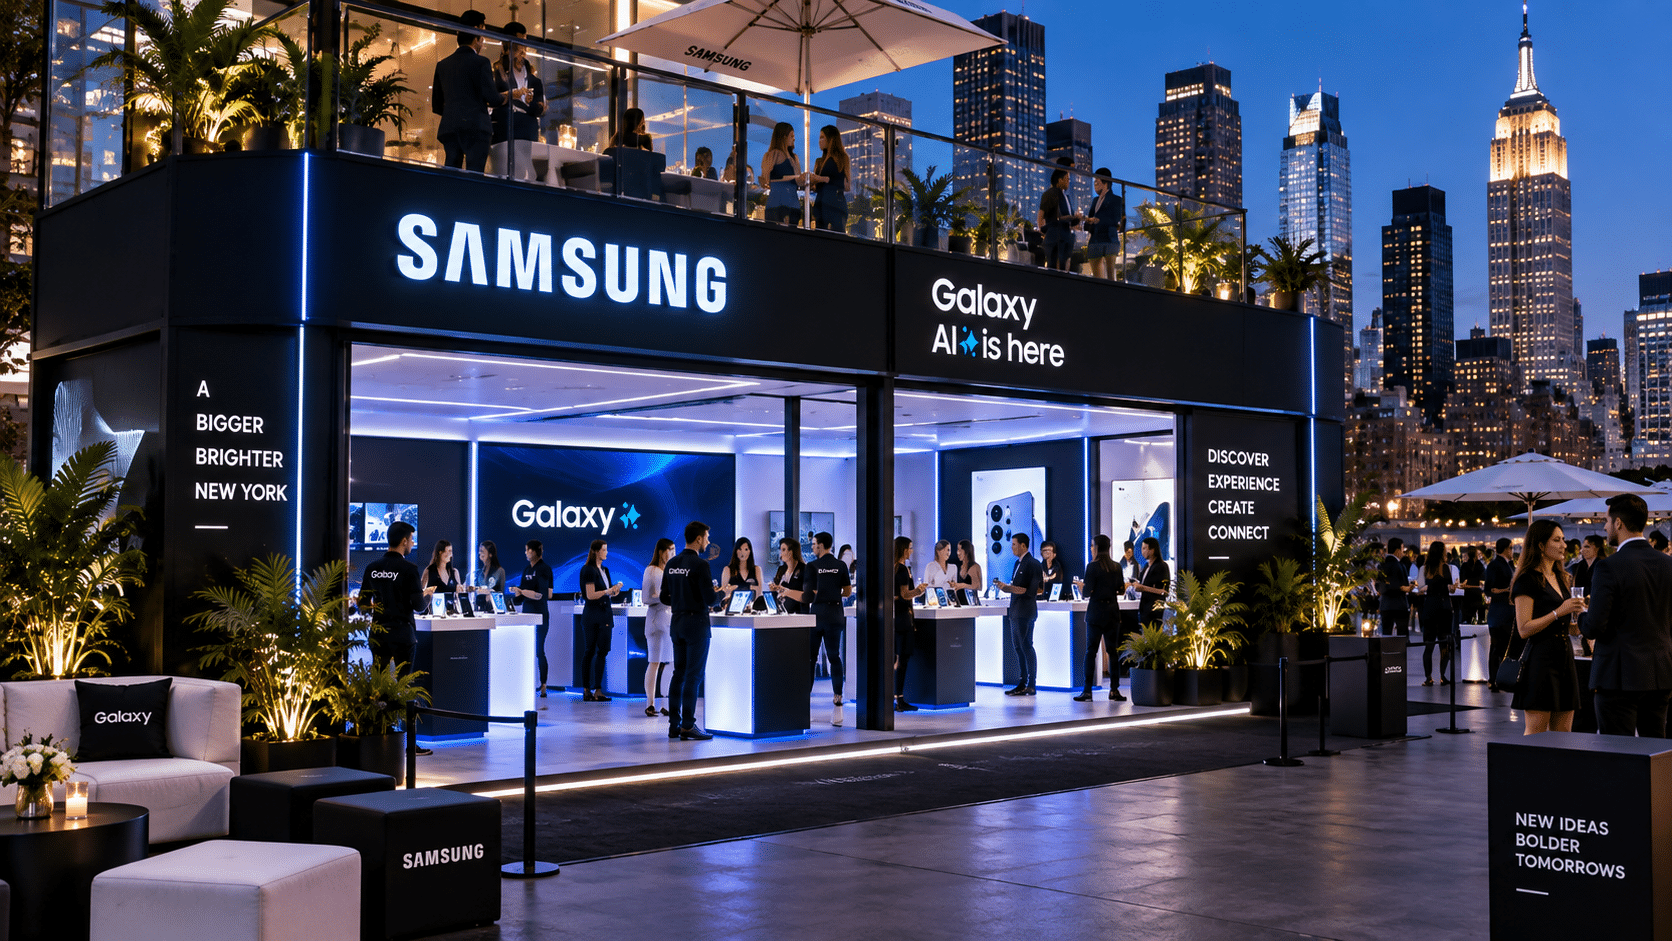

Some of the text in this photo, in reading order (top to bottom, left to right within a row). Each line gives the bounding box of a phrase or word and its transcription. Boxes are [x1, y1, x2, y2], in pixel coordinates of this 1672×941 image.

[684, 45, 752, 71] SAMSUNG
[396, 212, 729, 314] SAMSUNG
[931, 277, 1038, 330] Galaxy
[931, 323, 1066, 369] AI is here
[196, 379, 211, 398] A
[196, 413, 264, 434] BIGGER
[195, 447, 284, 468] BRIGHTER
[1207, 448, 1270, 467] DISCOVER
[195, 481, 288, 502] NEW YORK
[1207, 473, 1281, 492] EXPERIENCE
[511, 499, 616, 536] Galaxy
[1207, 499, 1256, 515] CREATE
[1207, 524, 1270, 540] CONNECT
[94, 709, 152, 727] Galaxy
[1515, 812, 1609, 836] NEW IDEAS
[1515, 831, 1581, 854] BOLDER
[402, 843, 485, 870] SAMSUNG
[1515, 853, 1626, 880] TOMORROWS
